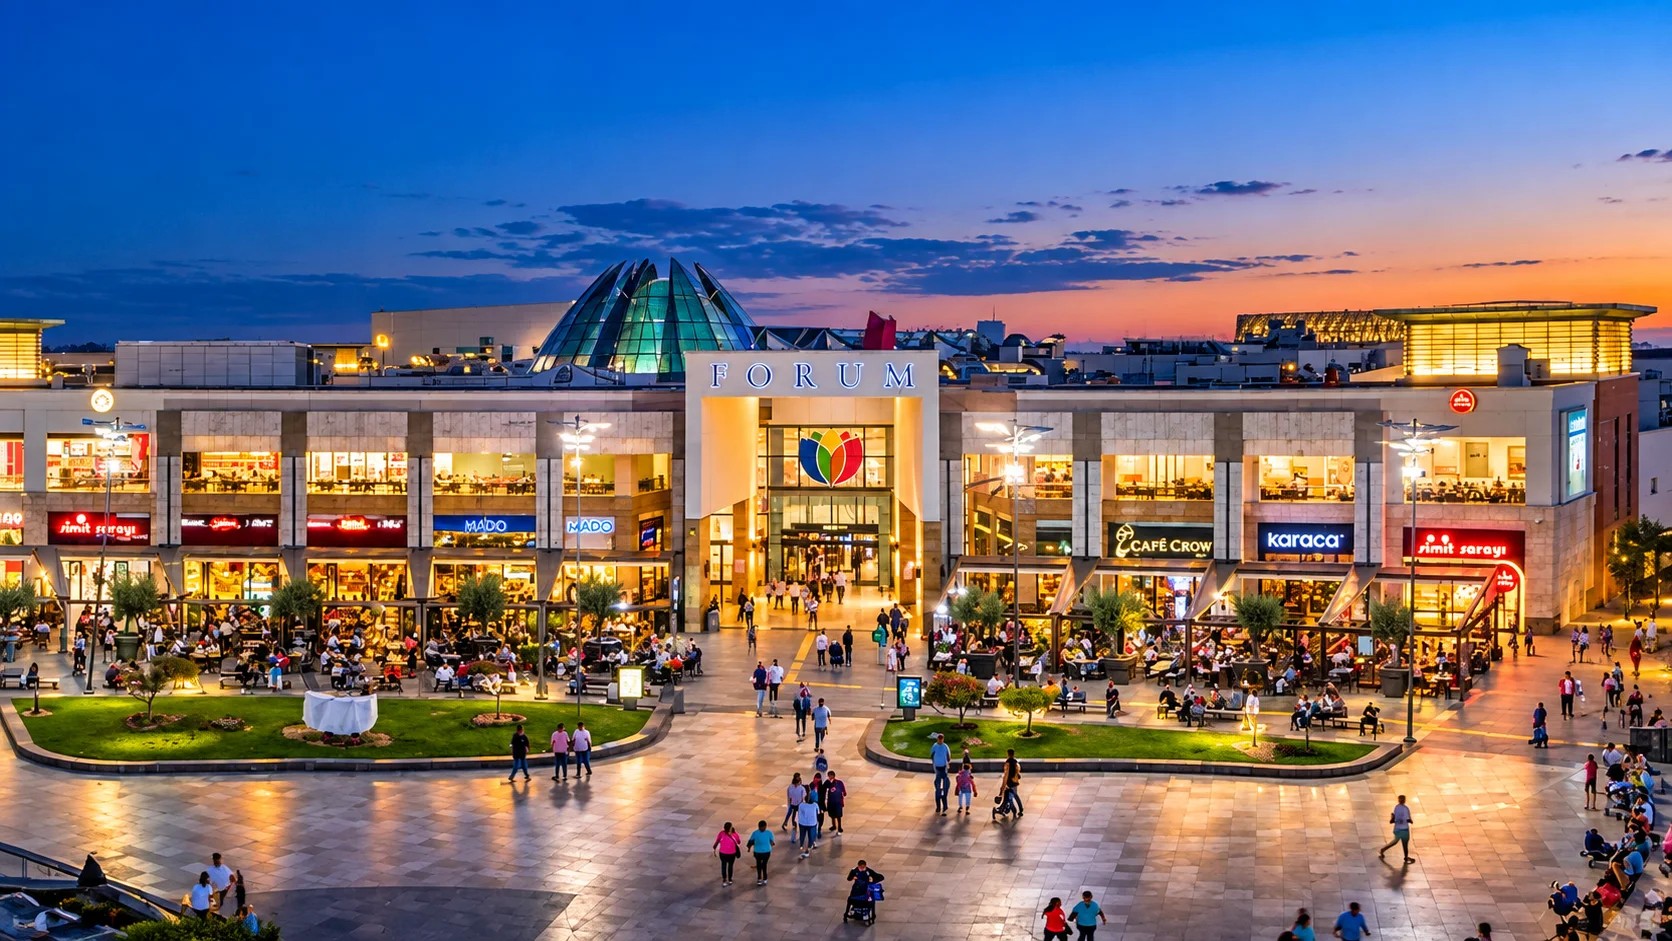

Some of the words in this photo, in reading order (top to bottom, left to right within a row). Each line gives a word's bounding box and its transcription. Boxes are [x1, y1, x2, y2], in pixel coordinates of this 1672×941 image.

[710, 363, 916, 389] FORUM
[60, 514, 91, 534] simit
[464, 519, 507, 532] MADO
[567, 519, 613, 533] MADO
[1170, 539, 1213, 552] CROW
[1267, 532, 1339, 549] karaca
[1418, 534, 1455, 554] simit
[1459, 545, 1507, 558] sarayı
